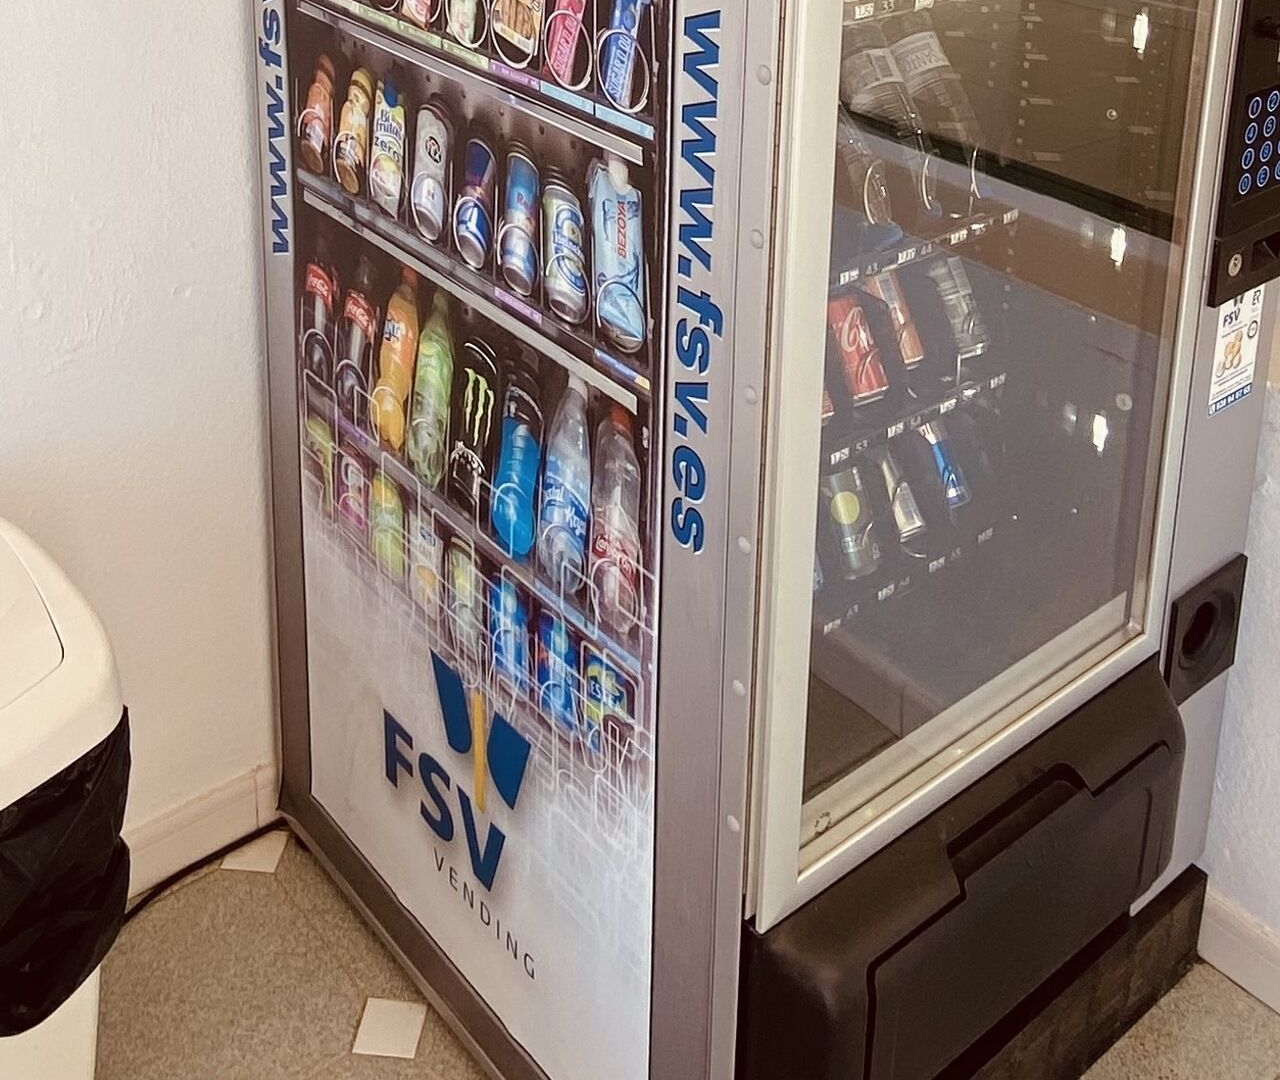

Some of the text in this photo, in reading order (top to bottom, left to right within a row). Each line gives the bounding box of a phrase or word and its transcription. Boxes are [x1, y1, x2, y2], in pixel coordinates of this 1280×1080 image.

[375, 136, 401, 162] zero
[616, 200, 627, 259] BEZOYA
[671, 9, 724, 556] www.fsv.es
[1222, 308, 1242, 328] FSV
[383, 707, 506, 893] FSV
[434, 847, 537, 980] VENDING
